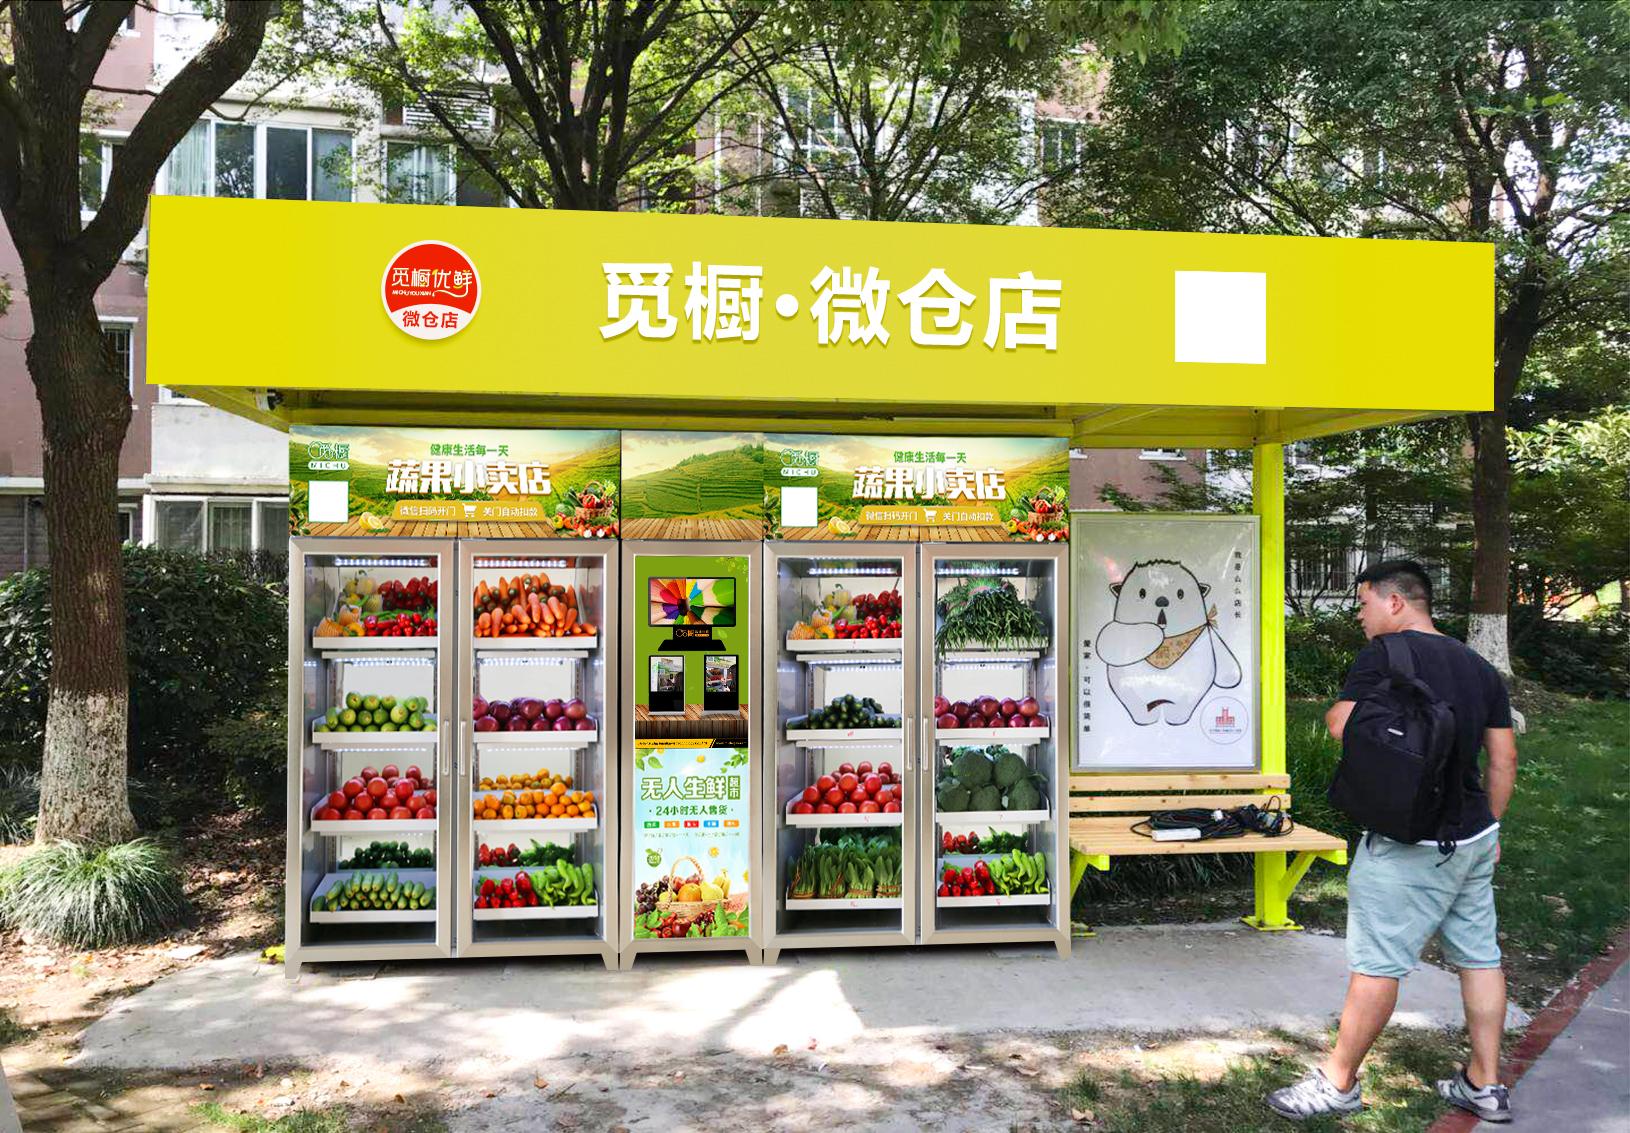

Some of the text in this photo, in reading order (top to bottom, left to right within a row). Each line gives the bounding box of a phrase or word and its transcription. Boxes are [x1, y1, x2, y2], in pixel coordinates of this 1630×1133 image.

[391, 267, 473, 293] 觅橱优鲜
[599, 261, 1063, 351] 觅橱·微仓店
[402, 310, 459, 329] 微仓店
[430, 443, 509, 457] 健康生活每一天
[893, 450, 967, 464] 健康生活每一天
[385, 458, 552, 495] 蔬果小卖店
[852, 466, 1006, 501] 蔬果小卖店
[400, 505, 538, 517] 微信扫码开门 关门自动扣款
[866, 511, 994, 522] 微信扫码开门 关门自动扣款
[641, 775, 727, 800] 无人生鲜
[655, 805, 728, 816] 24小时无人售货
